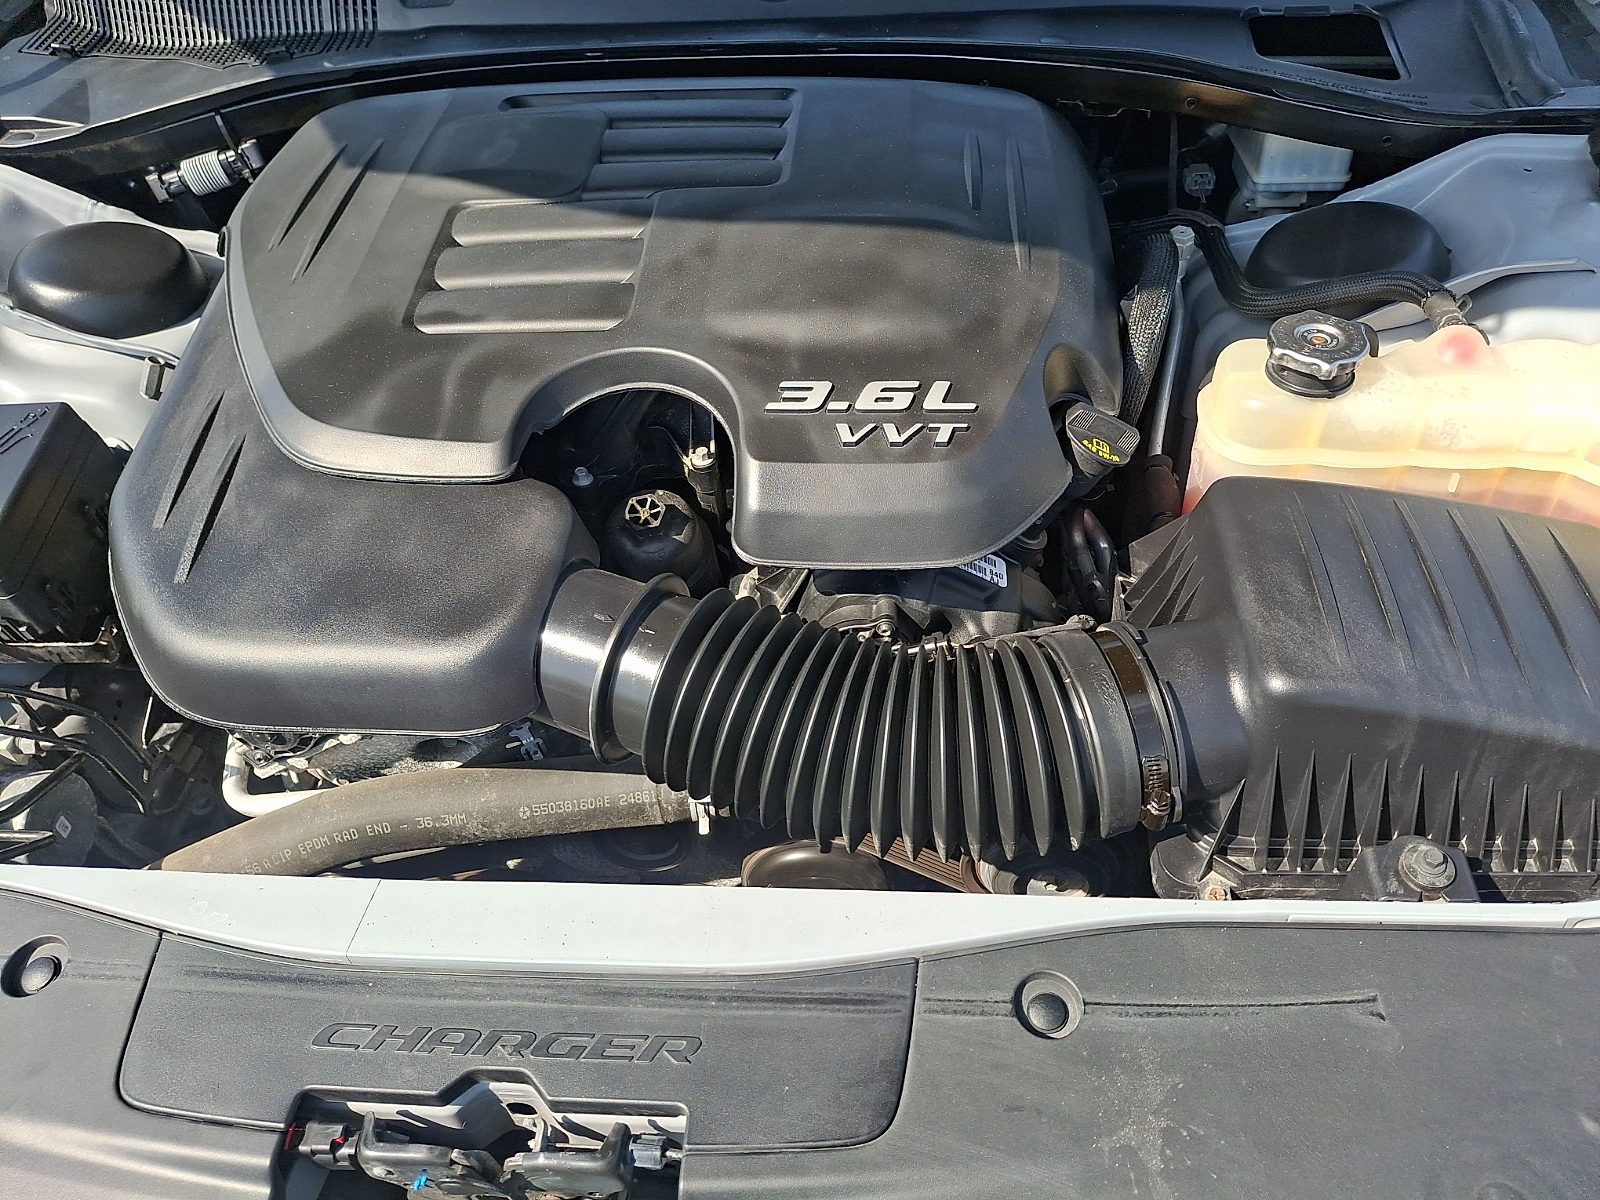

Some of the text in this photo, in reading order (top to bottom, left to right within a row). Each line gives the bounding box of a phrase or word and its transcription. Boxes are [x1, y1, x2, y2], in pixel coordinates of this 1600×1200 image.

[765, 380, 979, 413] 3.6L
[834, 423, 971, 448] VVT
[298, 835, 330, 855] EPDM
[332, 828, 359, 844] RAD
[365, 822, 391, 836] END
[414, 812, 467, 829] 36.3MM
[311, 1022, 703, 1065] CHARGER
